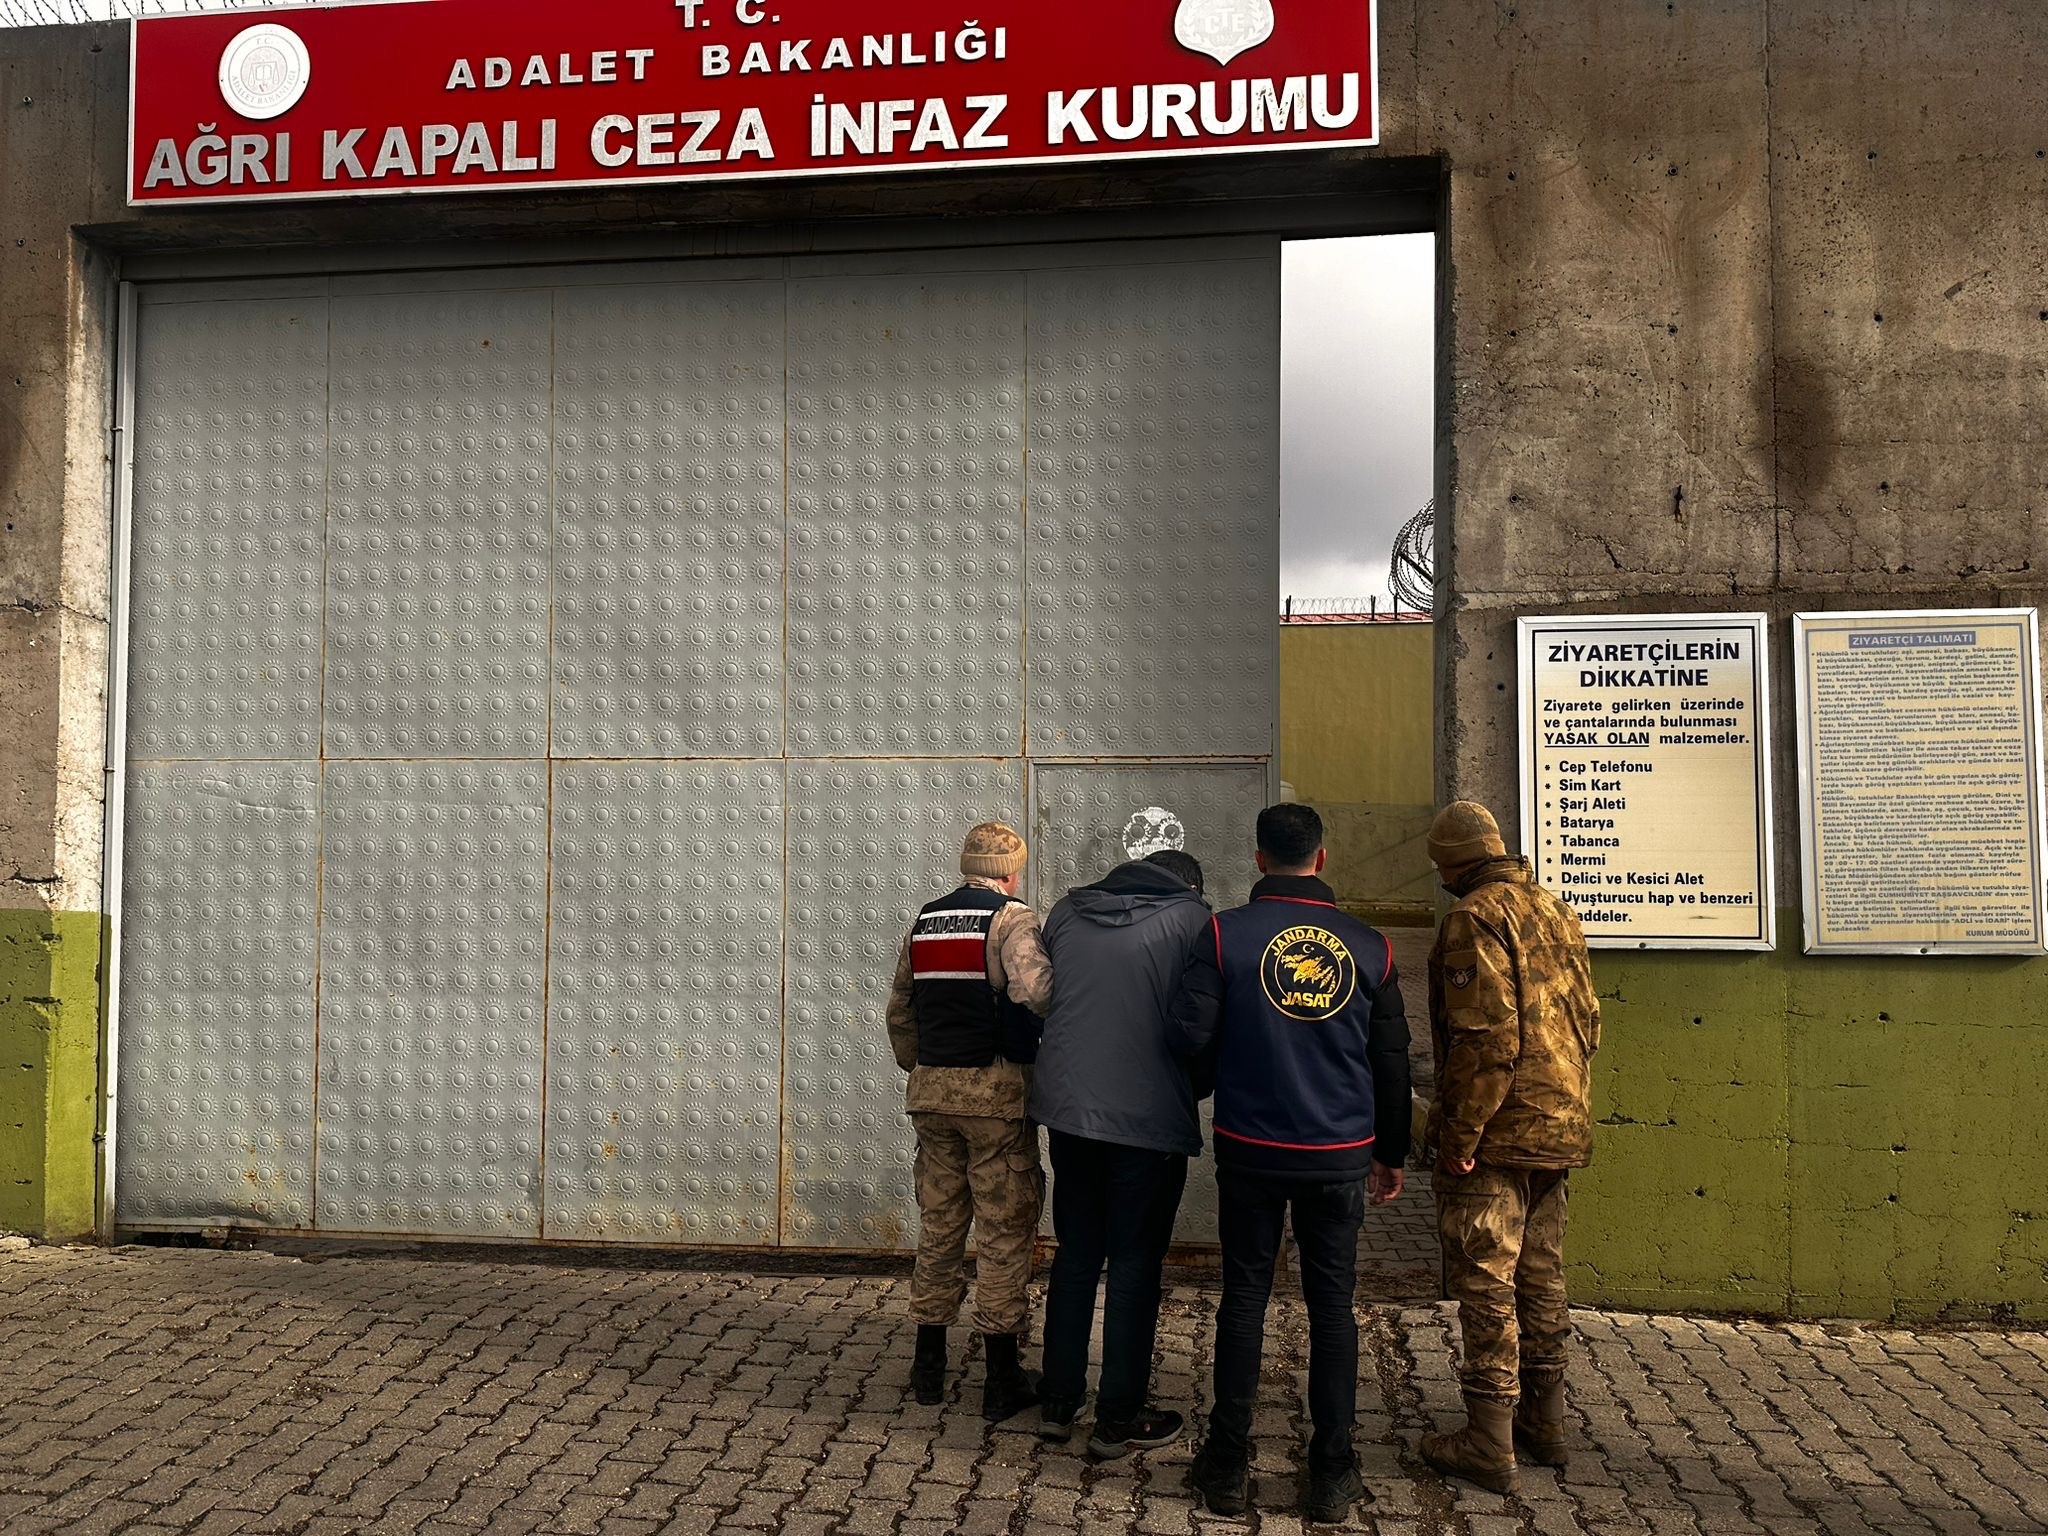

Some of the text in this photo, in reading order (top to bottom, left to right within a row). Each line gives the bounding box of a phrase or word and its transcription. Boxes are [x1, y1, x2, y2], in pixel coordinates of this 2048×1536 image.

[446, 19, 1007, 89] ADALET BAKANLIĞI
[143, 73, 1359, 187] AĞRI KAPALI CEZA İNFAZ KURUMU
[1549, 638, 1739, 665] ZİYARETÇİLERİN
[1581, 666, 1708, 687] DİKKATİNE
[1544, 698, 1743, 713] Ziyarete gelirken üzerinde
[1566, 716, 1655, 731] çantalarında
[1661, 715, 1736, 727] bulunması
[1544, 732, 1749, 744] YASAK OLAN malzemeler.
[1560, 761, 1652, 775] Cep Telefonu
[1560, 779, 1620, 791] Sim Kart
[1560, 798, 1625, 813] Şarj Aleti
[1561, 816, 1613, 830] Batarya
[1560, 835, 1619, 846] Tabanca
[1561, 853, 1605, 865] Mermi
[1562, 872, 1704, 884] Delici ve Kesici Alet
[1561, 891, 1752, 907] Uyuşturucu hap ve benzeri
[1577, 910, 1632, 922] addeler.
[920, 915, 981, 935] JANDARMA
[1271, 929, 1347, 961] JANDARMA
[1281, 991, 1333, 1008] JASAT
